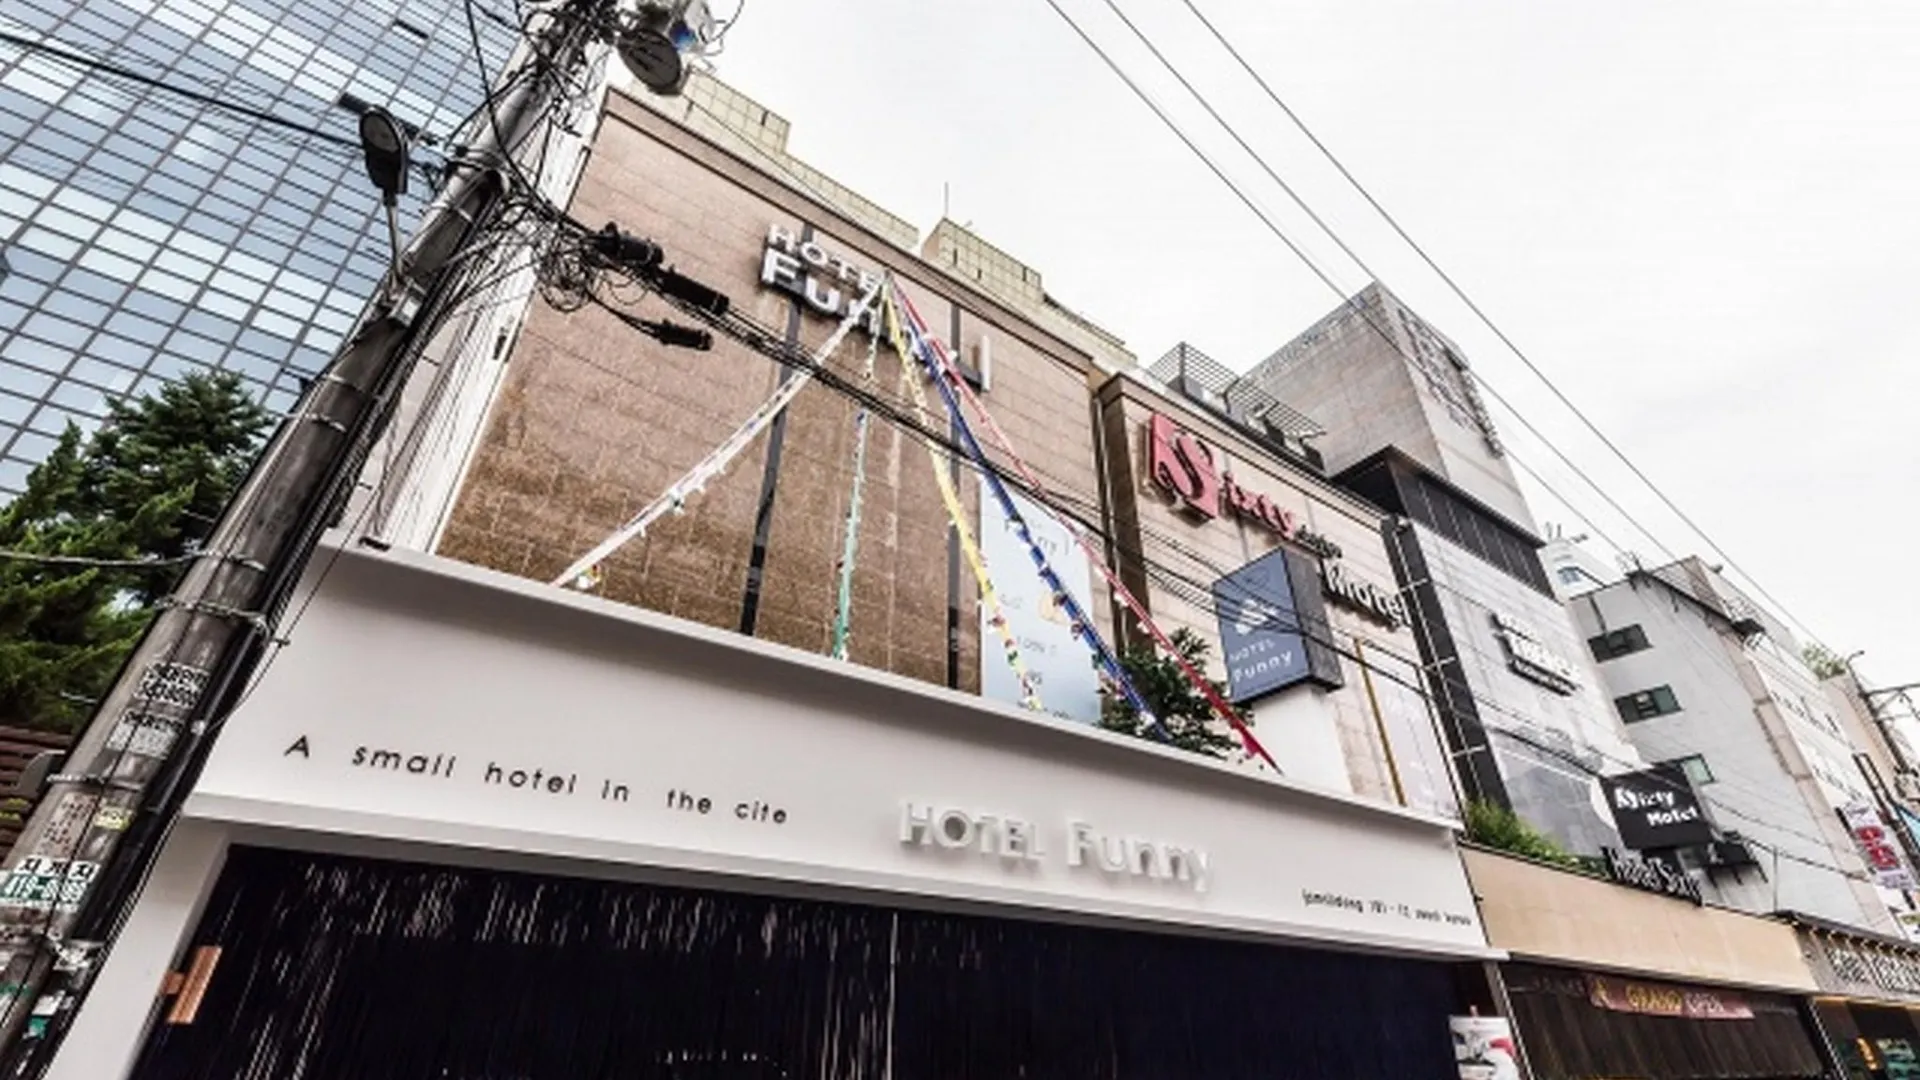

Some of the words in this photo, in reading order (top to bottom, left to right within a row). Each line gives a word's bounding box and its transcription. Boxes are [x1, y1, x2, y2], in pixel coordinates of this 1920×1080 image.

[284, 734, 311, 758] A
[351, 744, 456, 780] small
[484, 761, 577, 796] hotel
[602, 780, 631, 803] in
[667, 789, 713, 816] the
[735, 801, 788, 826] cite
[900, 802, 1047, 860] HOTEL
[1066, 818, 1213, 893] Funny
